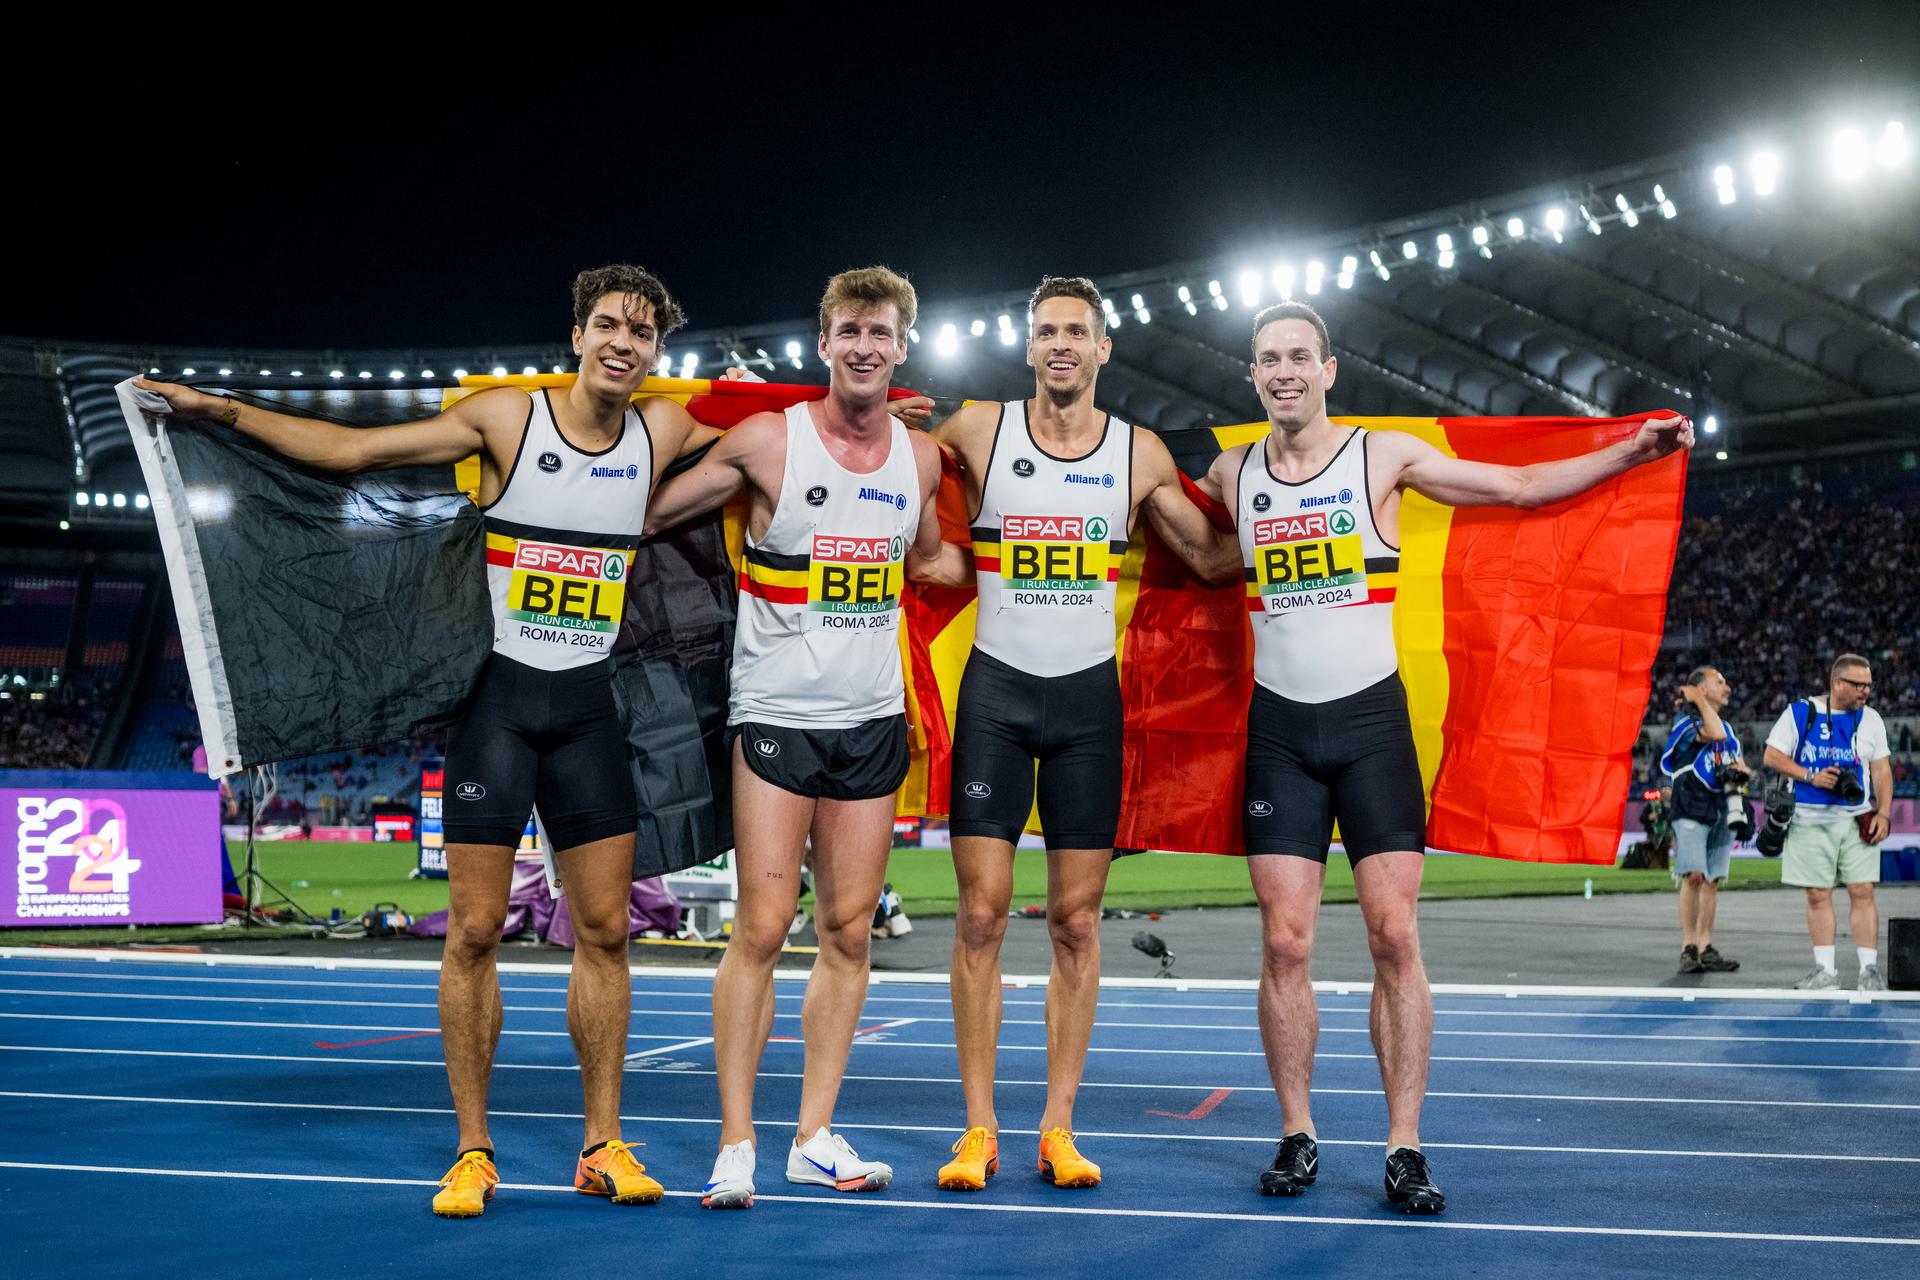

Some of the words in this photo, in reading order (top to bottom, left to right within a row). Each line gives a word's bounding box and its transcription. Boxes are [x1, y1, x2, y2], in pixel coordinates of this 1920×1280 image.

[590, 467, 625, 477] Allianz
[1064, 474, 1100, 485] Allianz
[858, 487, 894, 504] Allianz
[1300, 495, 1337, 508] Allianz
[1005, 519, 1081, 537] SPAR
[1255, 516, 1326, 542] SPAR
[815, 539, 889, 559] SPAR
[520, 547, 601, 574] SPAR
[1013, 545, 1098, 580] BEL
[1264, 542, 1353, 584] BEL
[821, 566, 895, 603] BEL
[1027, 581, 1049, 589] RUN
[1281, 582, 1303, 591] RUN
[520, 574, 612, 622] BEL
[1014, 593, 1058, 605] ROMA
[1061, 594, 1093, 605] 2024
[1271, 594, 1315, 610] ROMA
[1316, 588, 1353, 604] 2024
[837, 603, 860, 612] RUN
[536, 614, 560, 625] RUN
[822, 616, 866, 628] ROMA
[869, 614, 890, 628] 2024
[520, 625, 567, 644] ROMA
[570, 633, 605, 648] 2024
[17, 797, 48, 893] roma
[17, 904, 130, 917] CHAMPIONSHIPS
